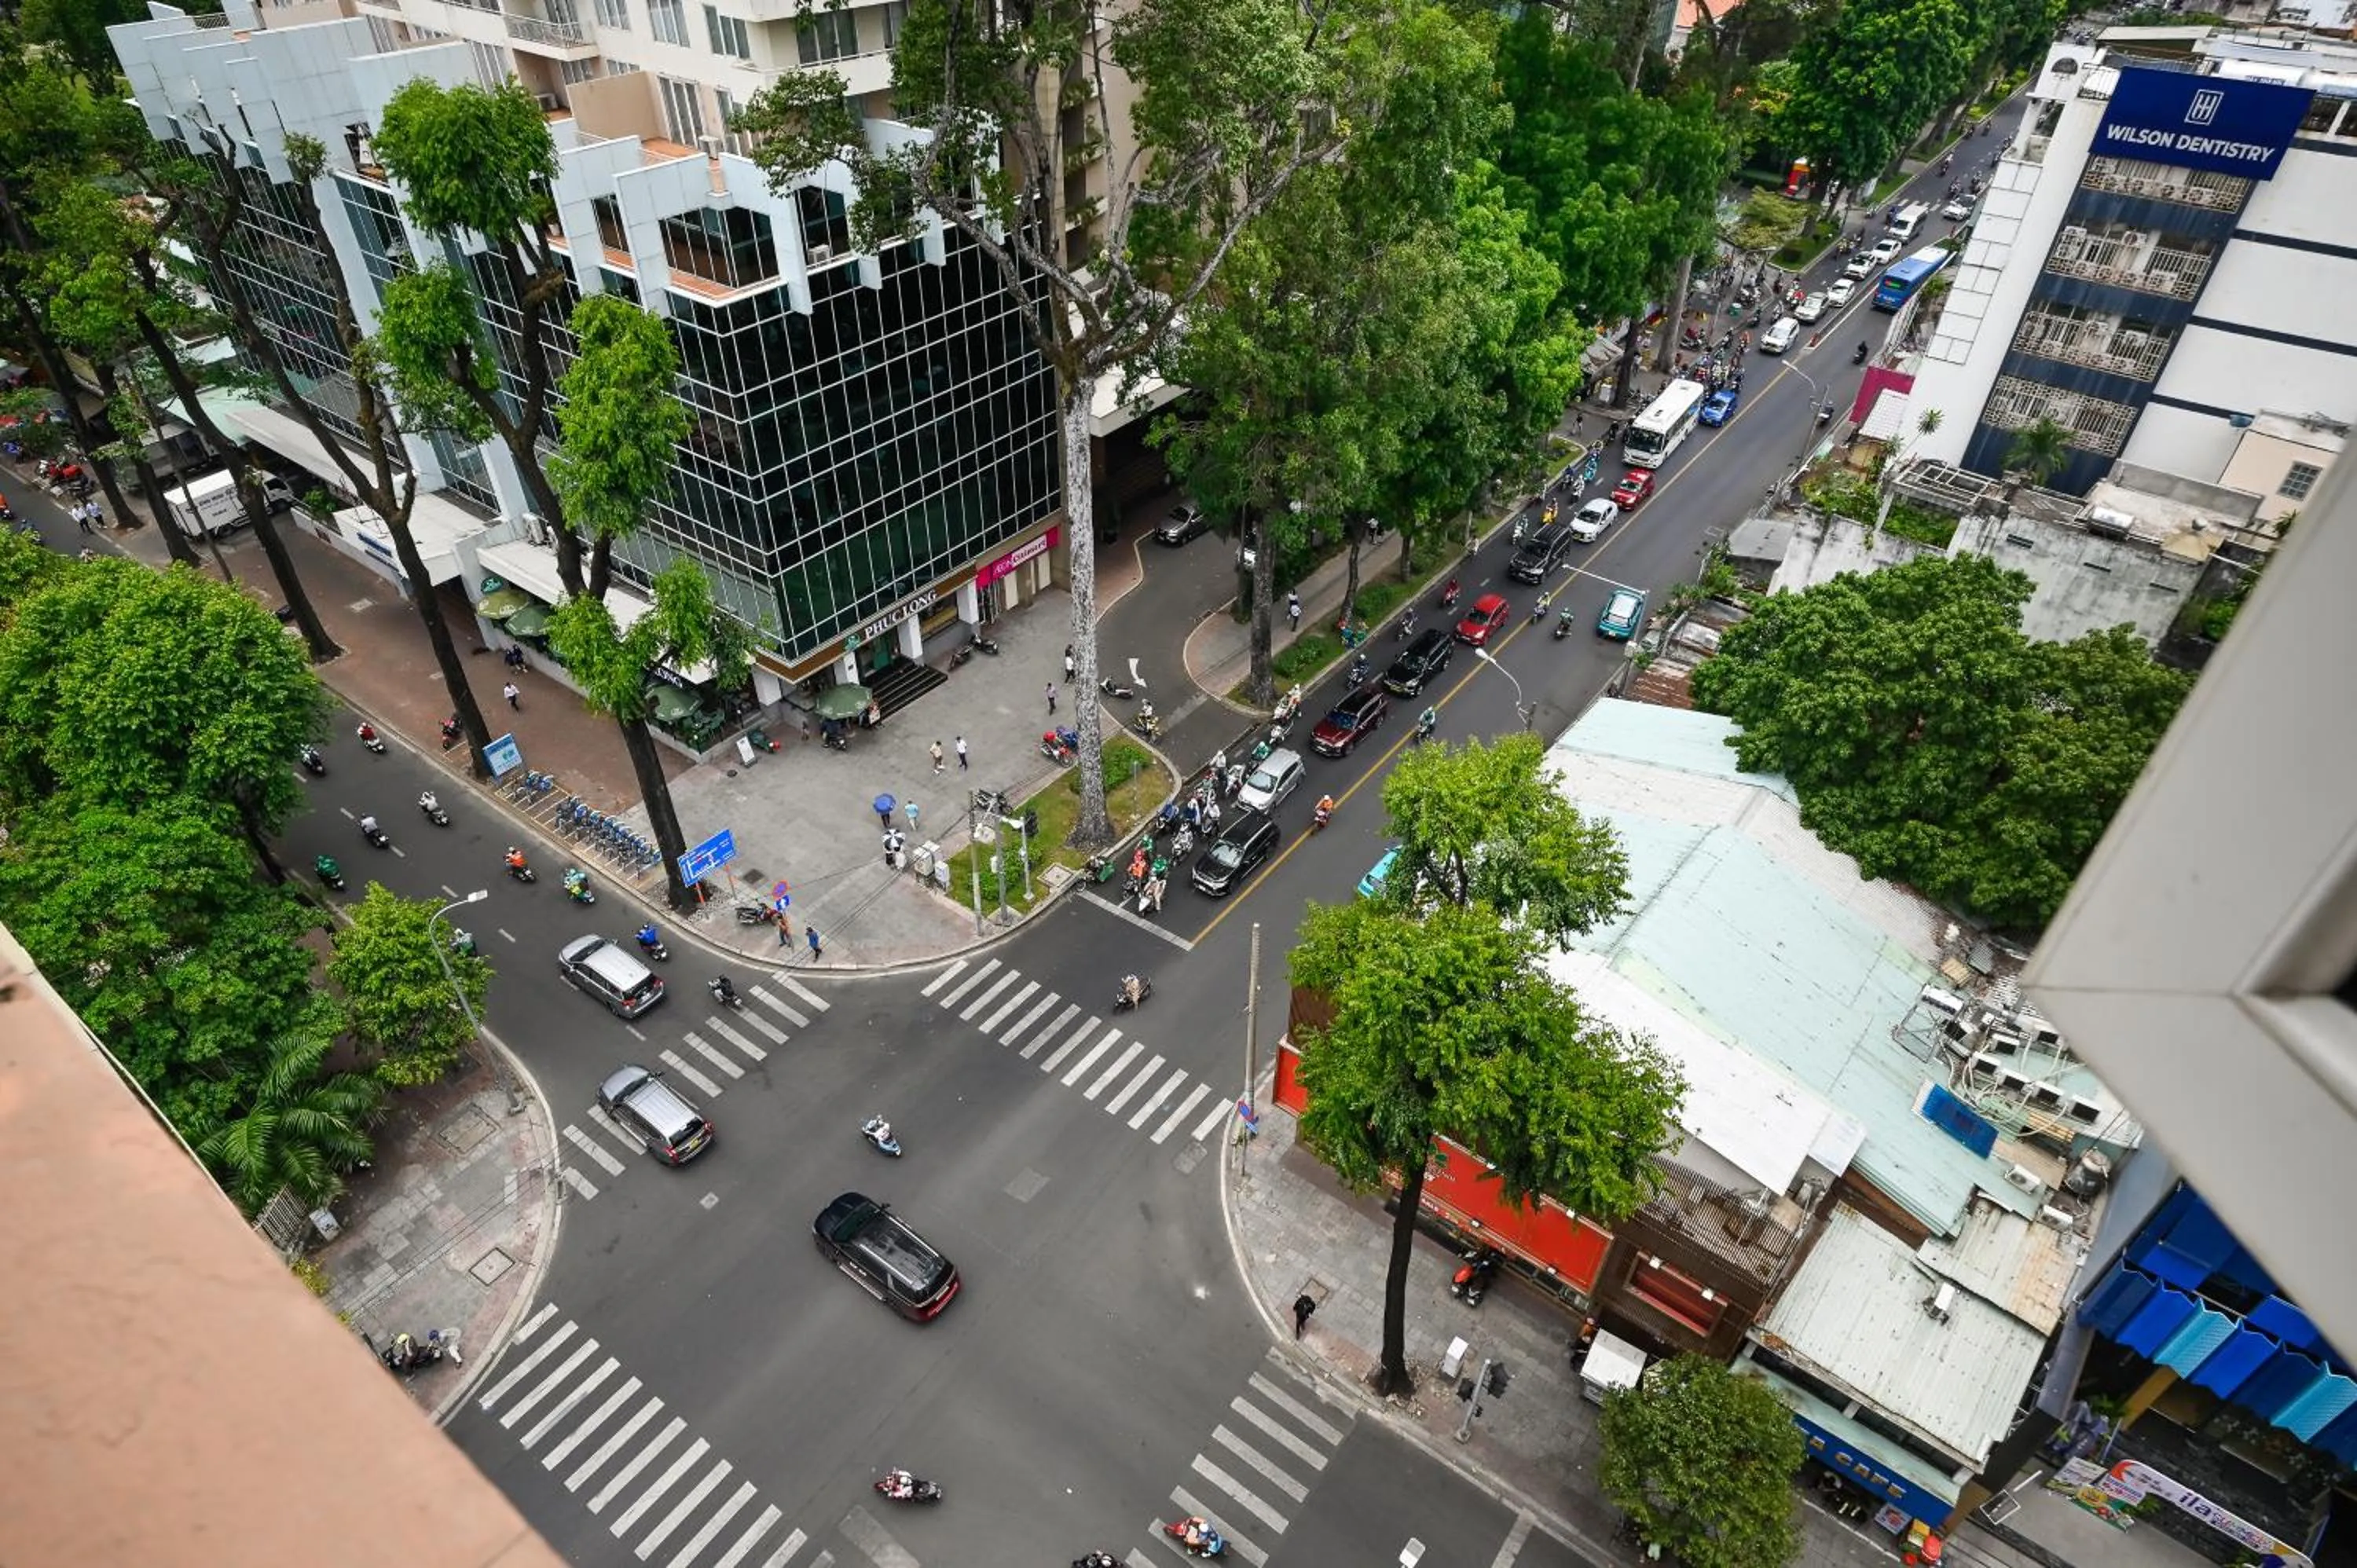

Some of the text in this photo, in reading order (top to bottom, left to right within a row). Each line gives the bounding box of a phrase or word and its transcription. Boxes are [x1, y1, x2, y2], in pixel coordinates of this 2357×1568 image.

[2106, 123, 2275, 163] WILSON DENTISTRY
[902, 589, 937, 619] LONG
[2179, 1492, 2212, 1516] ila
